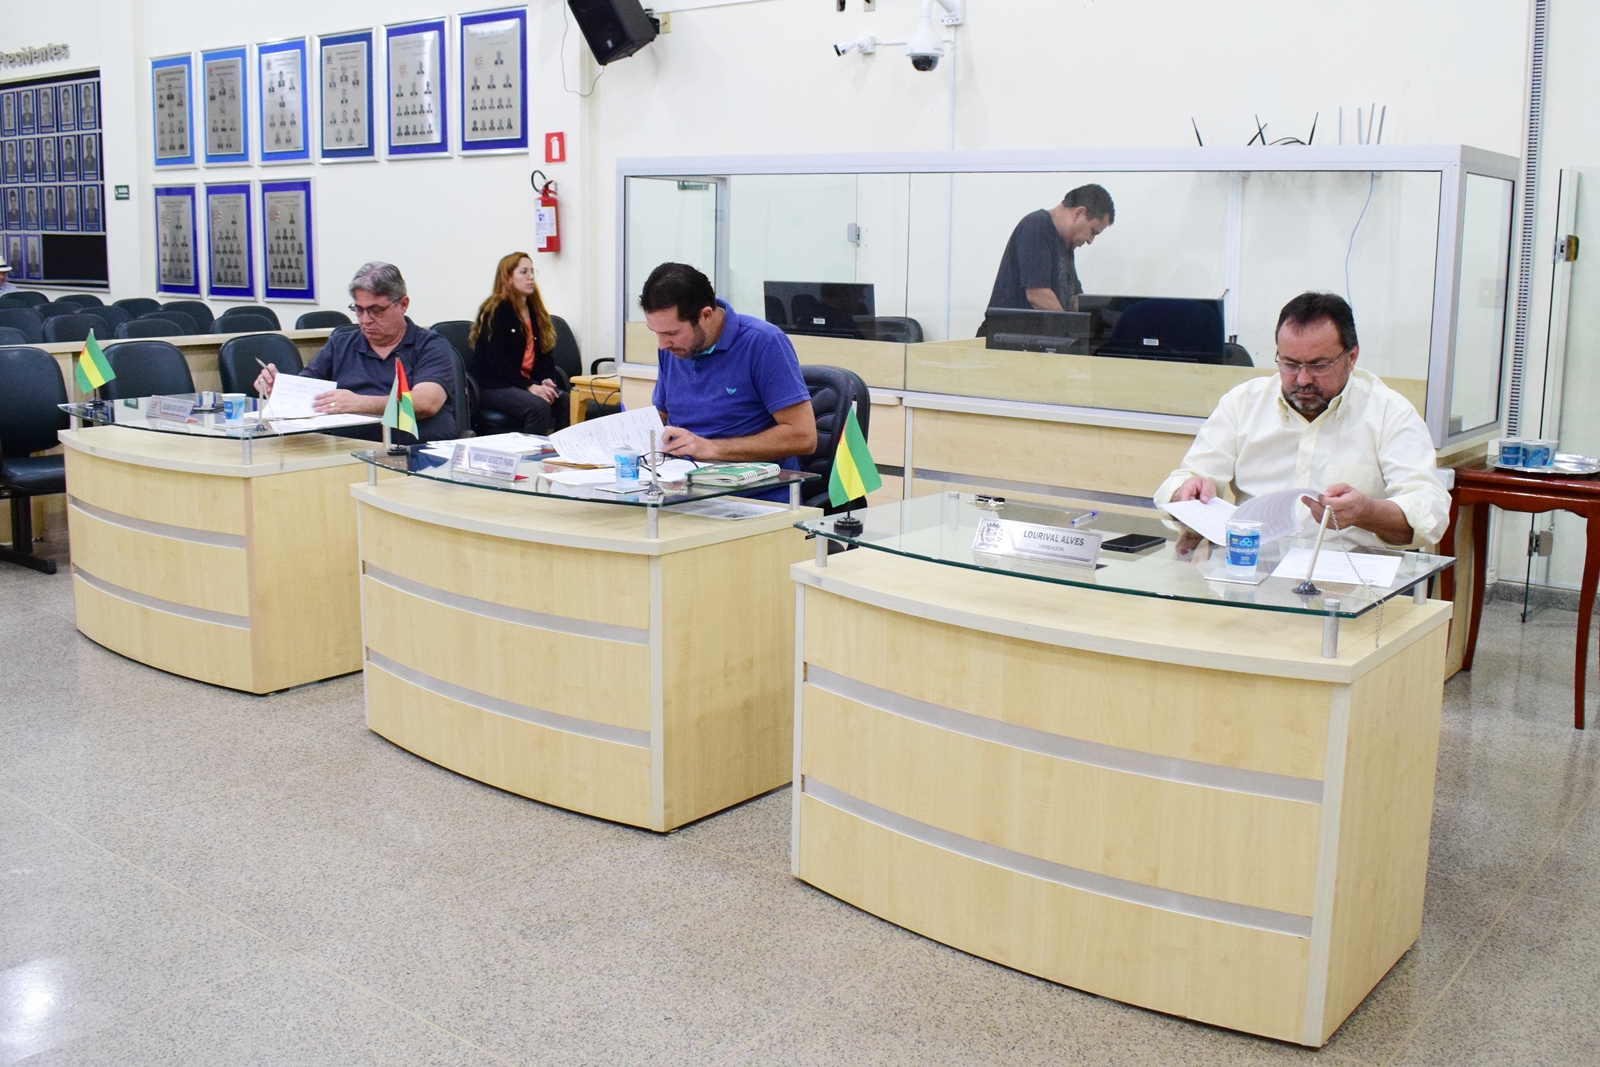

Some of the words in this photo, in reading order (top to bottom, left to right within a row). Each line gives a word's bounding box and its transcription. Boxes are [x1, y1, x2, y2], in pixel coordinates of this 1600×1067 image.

[1023, 530, 1059, 543] LOURIVAL
[1060, 535, 1085, 546] ALVES
[1038, 544, 1065, 552] VEREADOR
